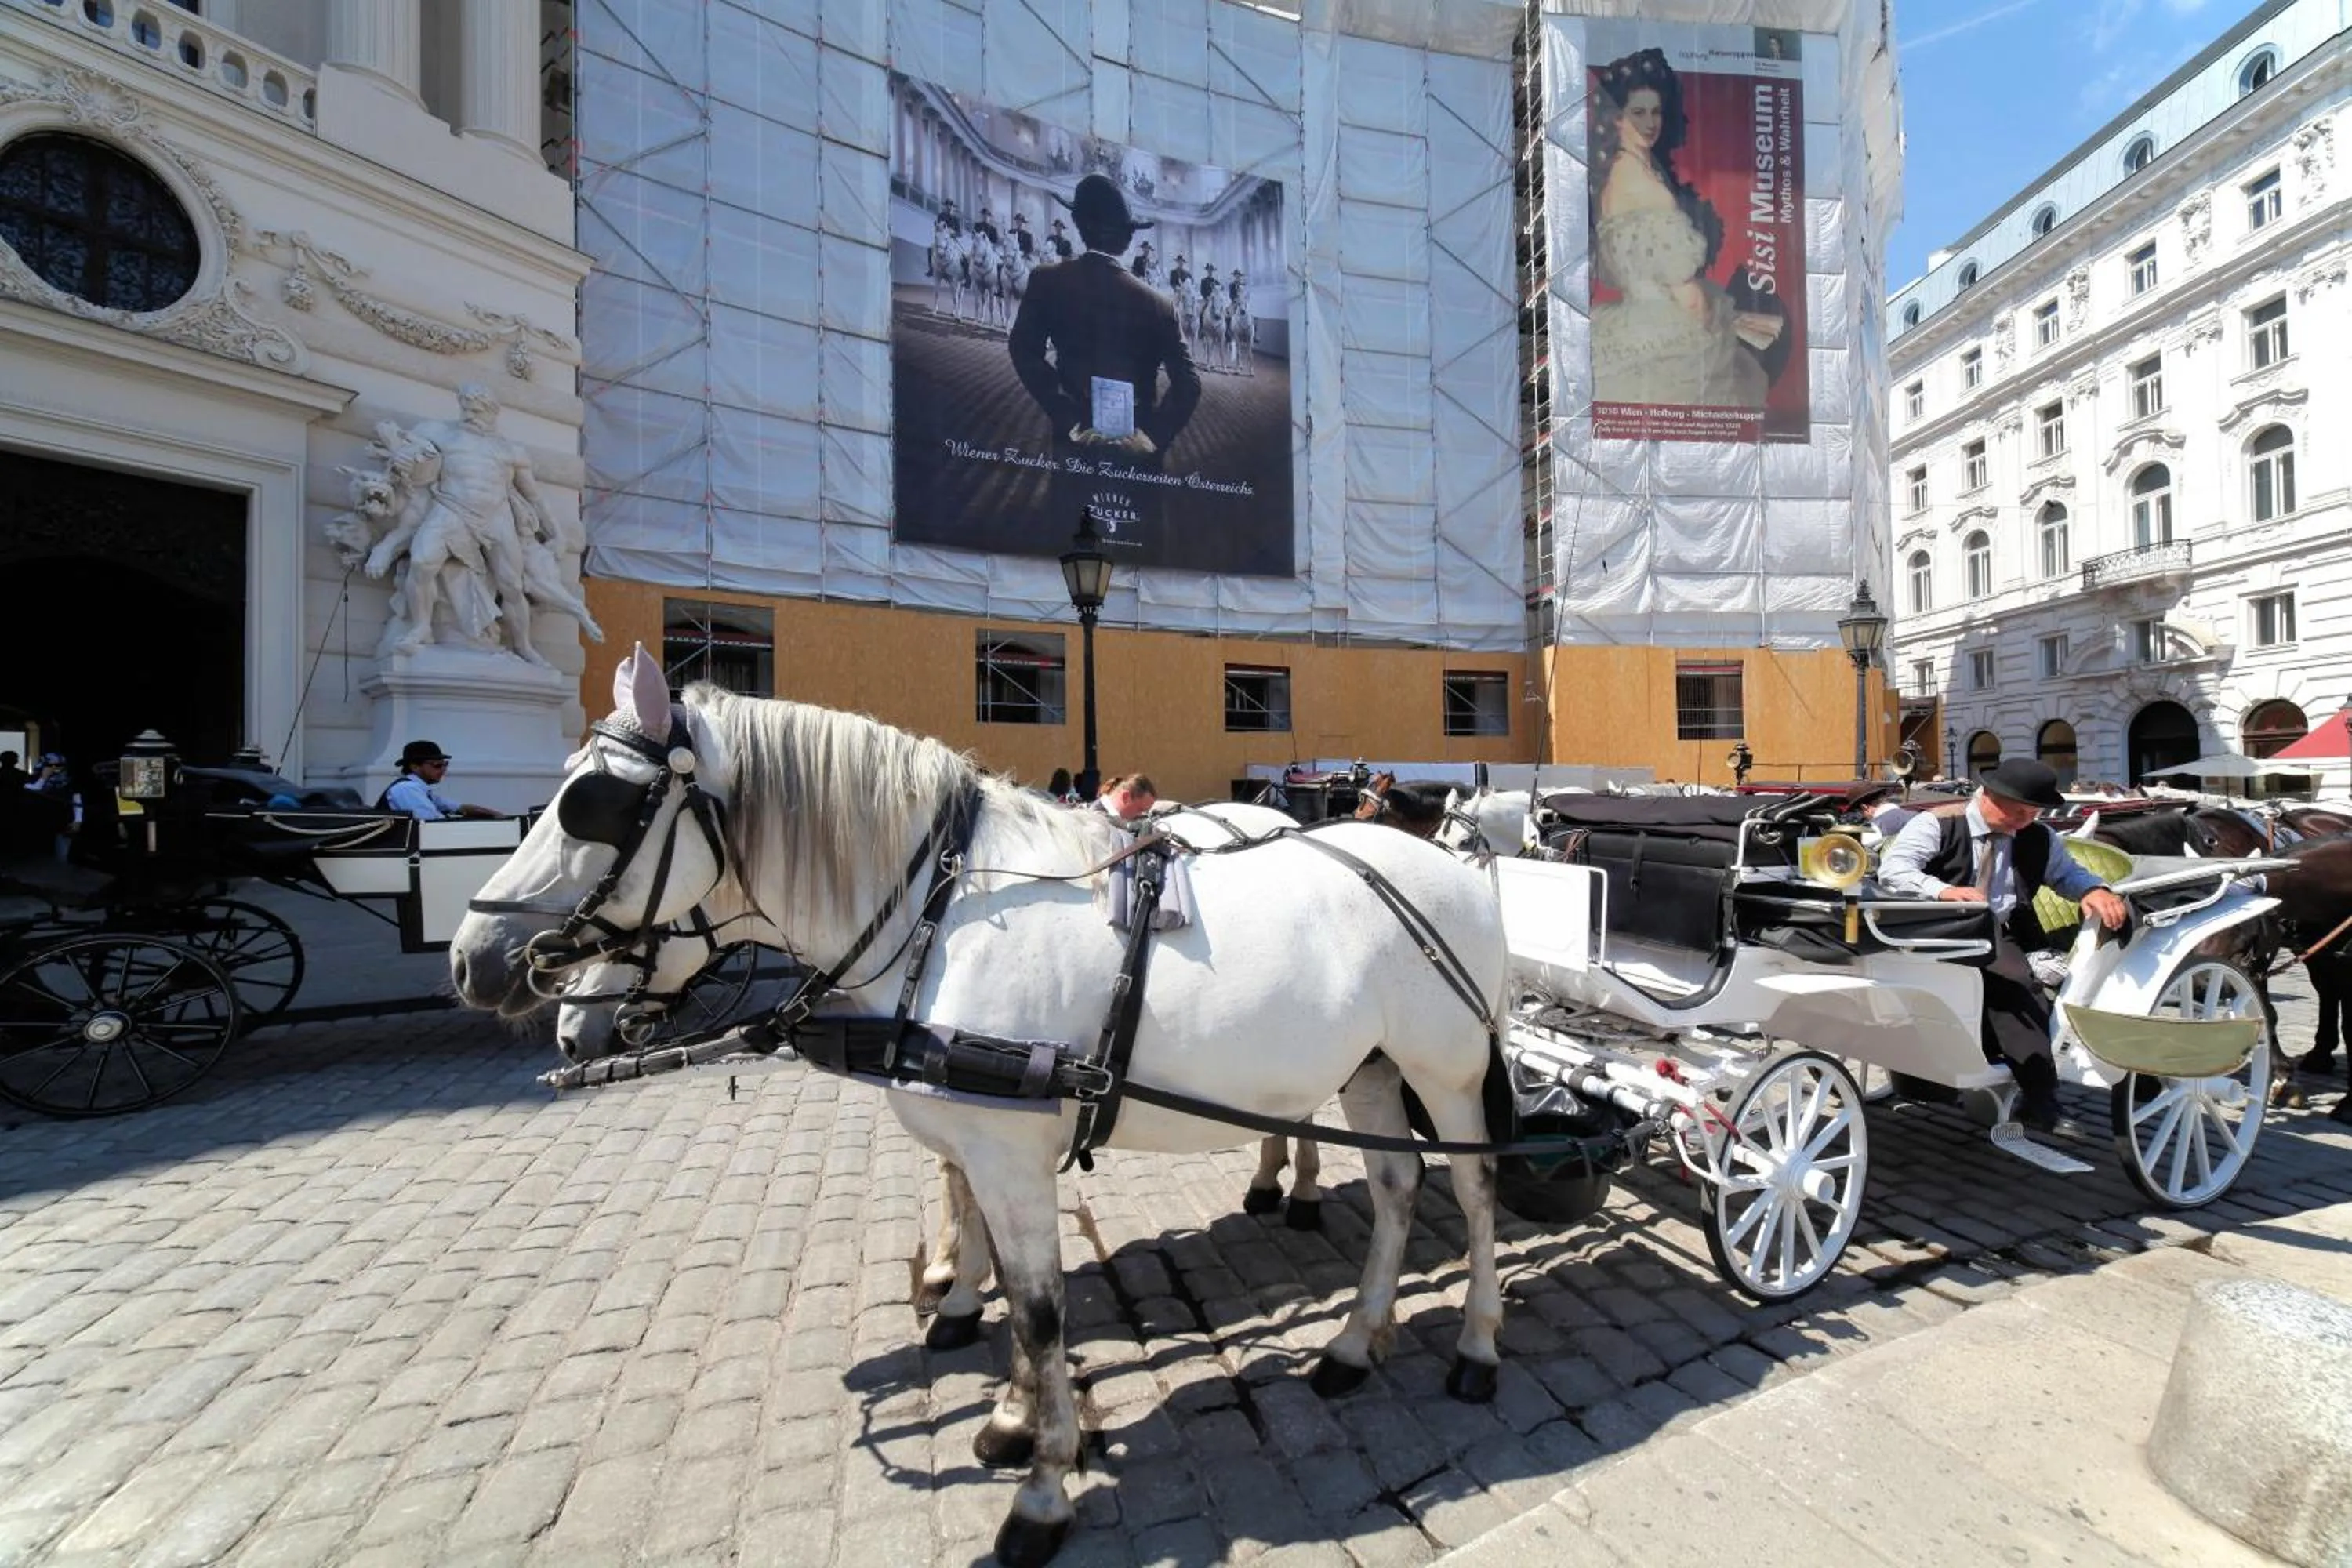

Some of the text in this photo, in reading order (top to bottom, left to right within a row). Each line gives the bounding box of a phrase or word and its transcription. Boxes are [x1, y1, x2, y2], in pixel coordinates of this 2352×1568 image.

[1749, 85, 1774, 223] Museum
[1778, 87, 1795, 223] Mythos & Wahrheit
[1746, 229, 1776, 295] Sisi
[1621, 406, 1643, 417] Wien
[944, 438, 1001, 461] Wiener
[1065, 457, 1096, 474] Die
[1098, 461, 1182, 487] Zuckerseiten
